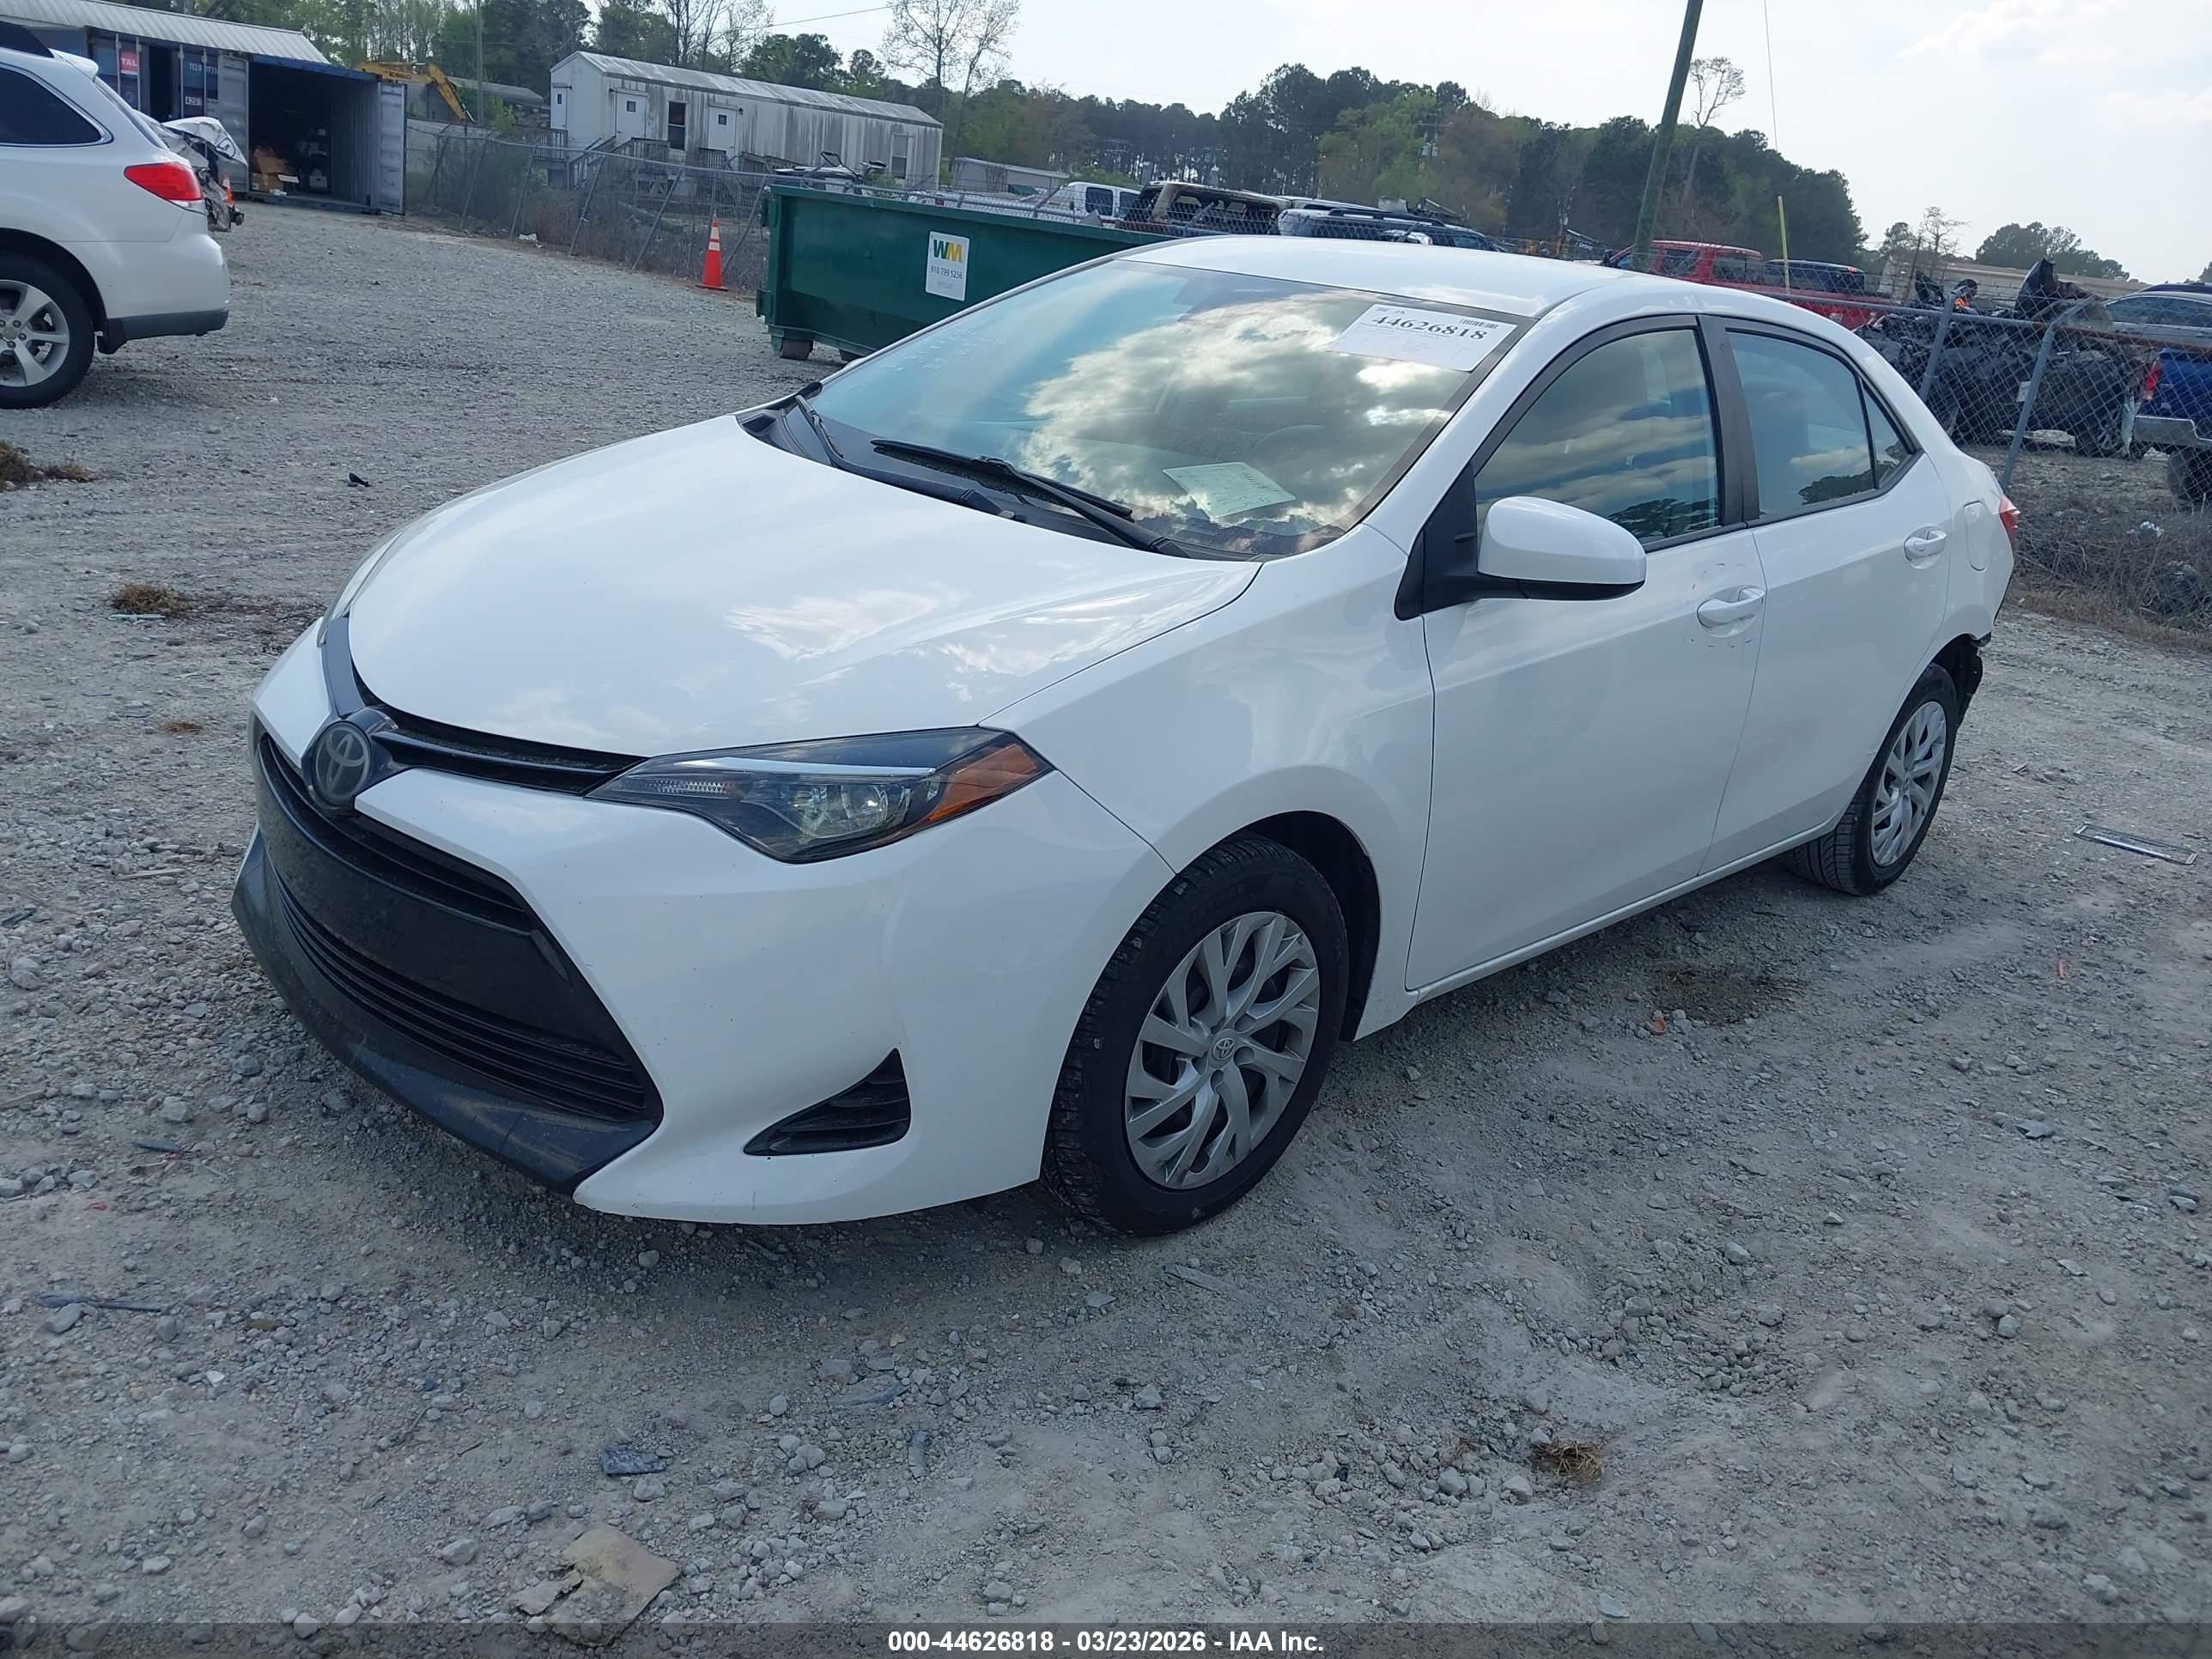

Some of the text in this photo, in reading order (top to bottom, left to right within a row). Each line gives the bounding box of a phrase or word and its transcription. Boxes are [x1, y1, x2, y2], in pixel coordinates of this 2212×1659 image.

[933, 239, 963, 263] WM
[930, 265, 939, 274] 910
[1372, 315, 1488, 341] 44626818
